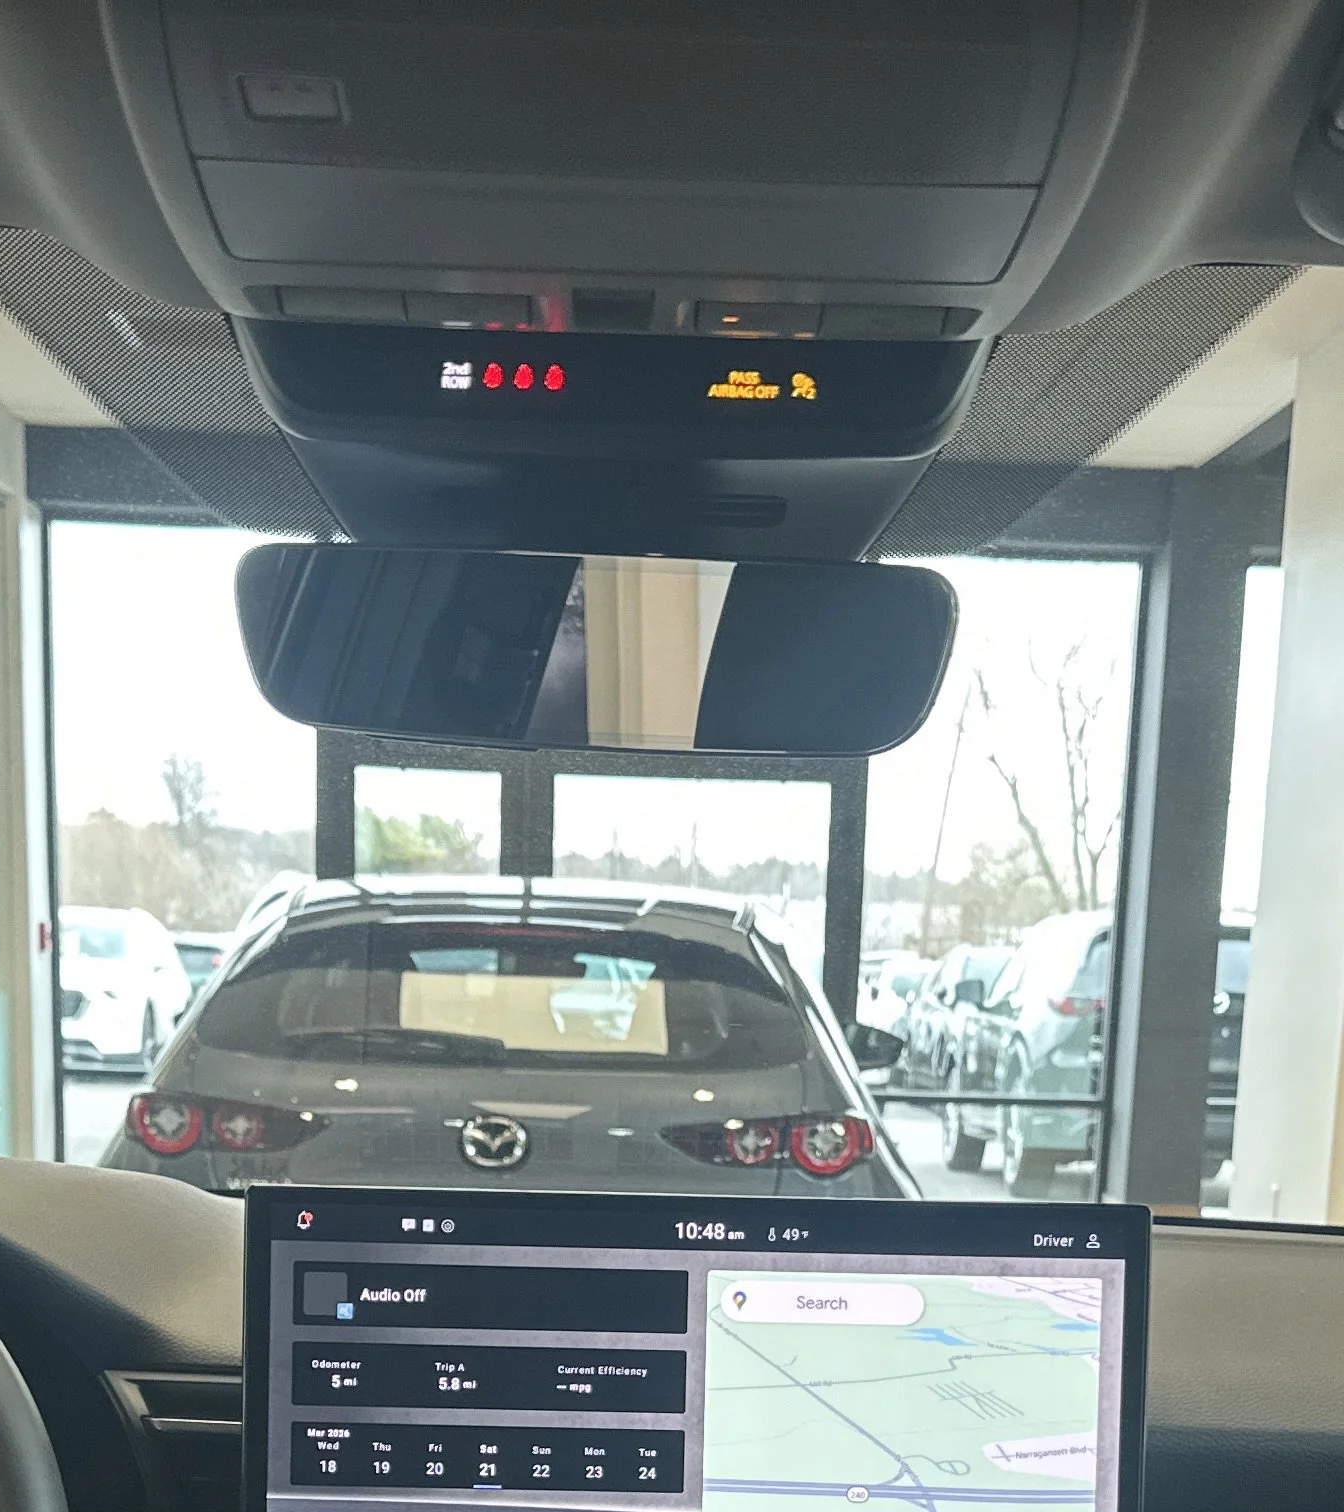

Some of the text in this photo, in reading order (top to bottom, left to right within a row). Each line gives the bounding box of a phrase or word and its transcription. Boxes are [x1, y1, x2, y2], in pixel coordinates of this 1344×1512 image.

[441, 361, 472, 375] 2nd
[440, 376, 472, 389] ROW
[729, 370, 761, 385] PASS
[707, 384, 780, 399] AIRBAG OFF
[675, 1222, 725, 1240] 10:48
[727, 1231, 745, 1240] am
[1033, 1233, 1074, 1248] Driver
[360, 1288, 426, 1302] Audio Off
[796, 1295, 848, 1310] Search
[311, 1359, 362, 1370] Odometer
[435, 1362, 465, 1373] Trip A
[557, 1365, 648, 1377] Current Efficiency
[331, 1374, 357, 1388] 5 mi
[438, 1377, 477, 1390] 5.8 mi
[569, 1383, 592, 1393] mpg
[307, 1428, 351, 1438] Mar 2026
[317, 1441, 657, 1457] Wed Thu Fri Sat Sun Mon Tue
[319, 1460, 656, 1480] 18 19 20 21 22 23 24
